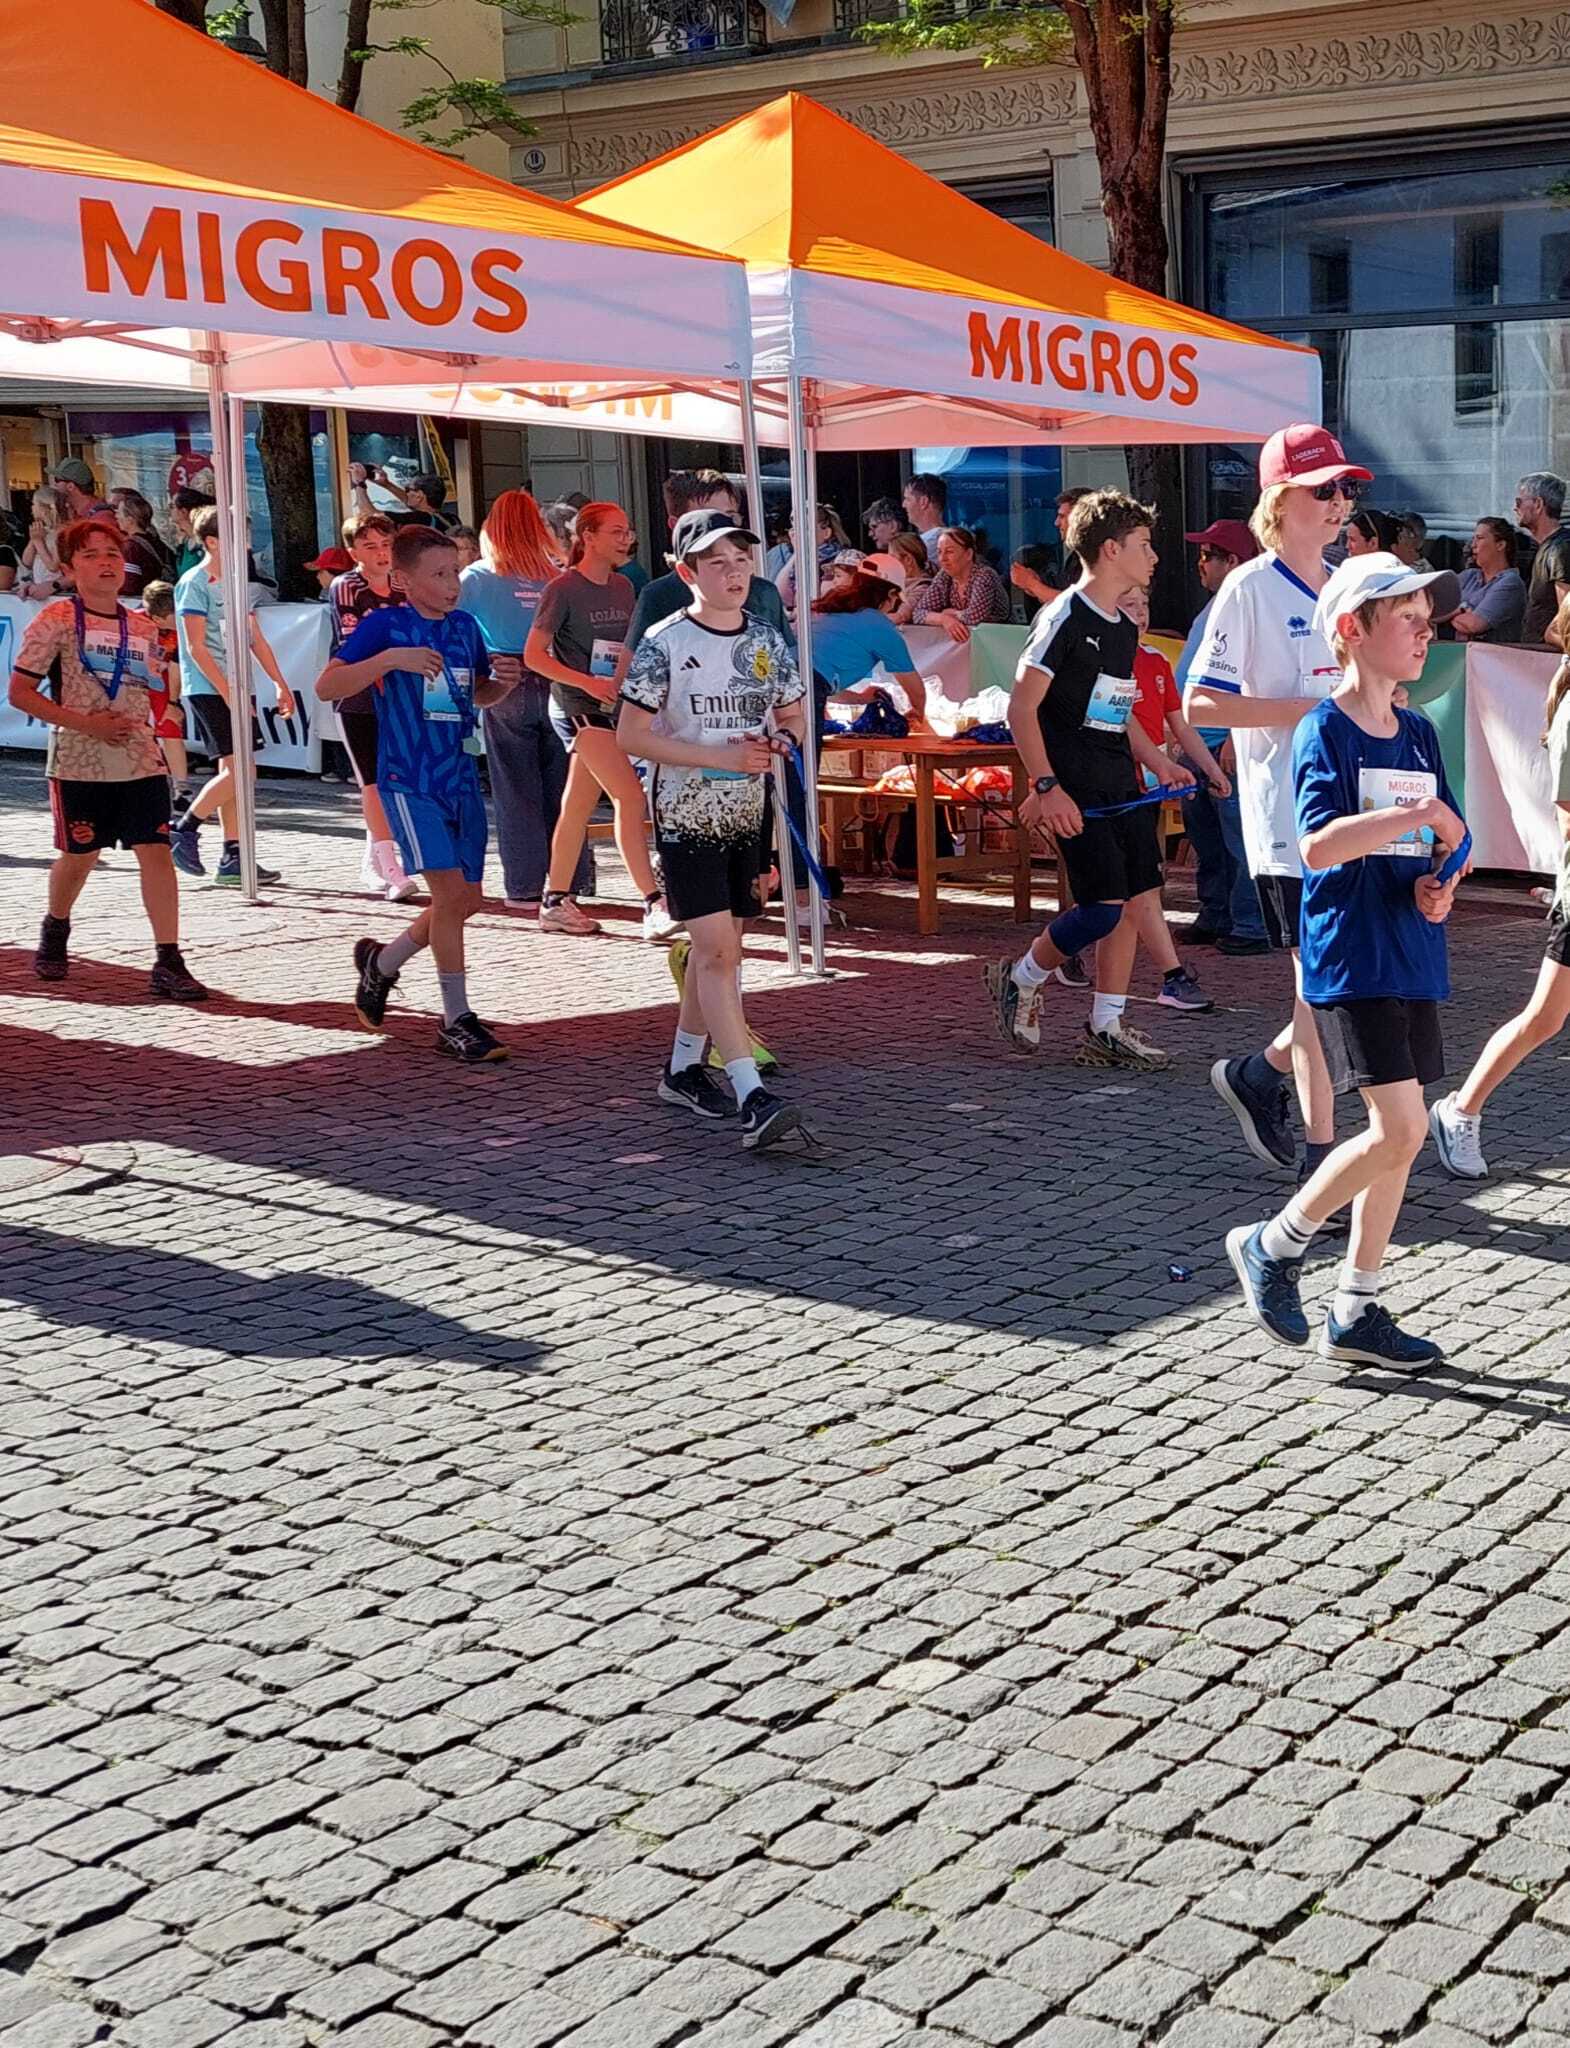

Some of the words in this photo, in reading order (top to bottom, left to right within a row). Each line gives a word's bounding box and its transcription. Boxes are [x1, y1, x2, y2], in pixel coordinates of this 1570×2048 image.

[79, 197, 528, 333] MIGROS
[968, 311, 1199, 406] MIGROS
[96, 644, 145, 661] MATIEU
[1388, 781, 1428, 794] MIGROS
